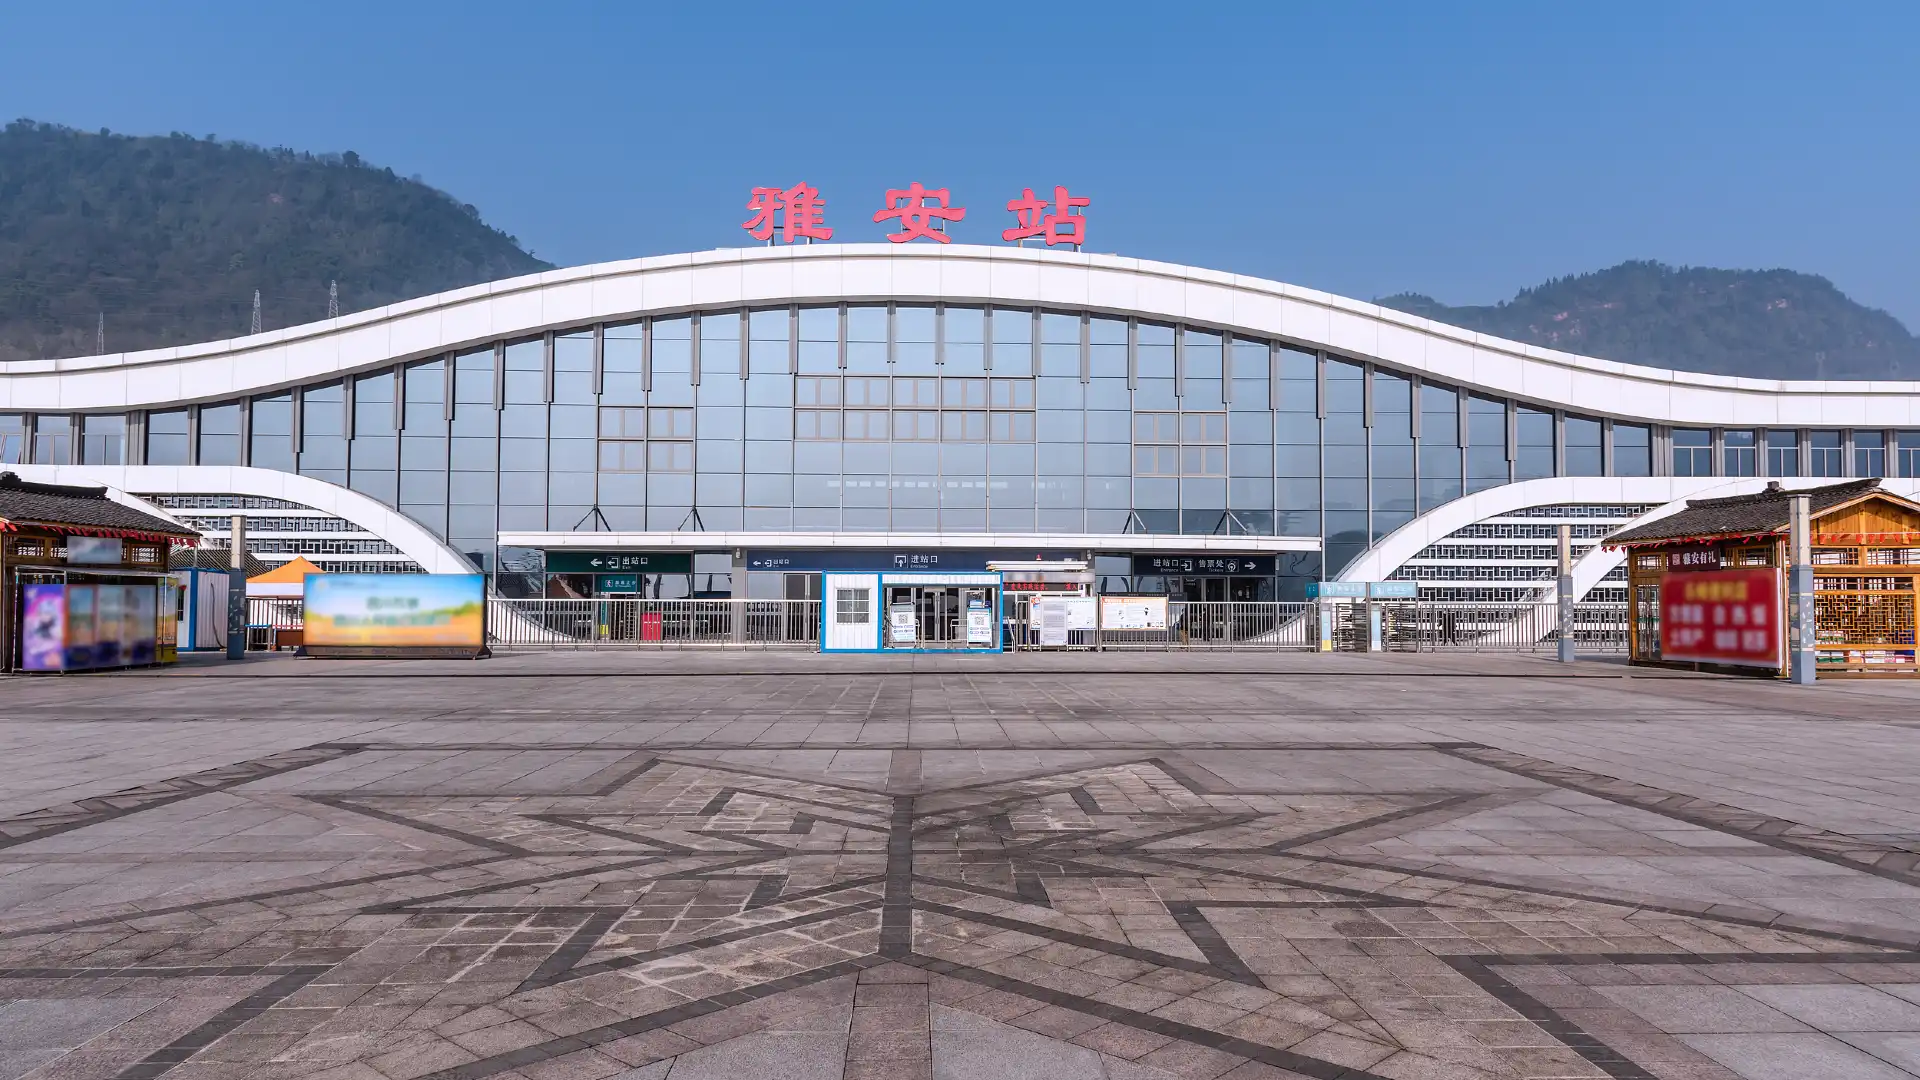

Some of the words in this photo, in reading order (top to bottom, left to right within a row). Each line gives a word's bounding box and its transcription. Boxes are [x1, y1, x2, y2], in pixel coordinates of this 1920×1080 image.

[741, 181, 1092, 247] 雅安站
[622, 556, 648, 565] 出站口
[910, 554, 938, 564] 进站口
[1153, 558, 1179, 567] 进站口
[1198, 559, 1224, 568] 售票处
[1682, 551, 1717, 565] 雅安有礼
